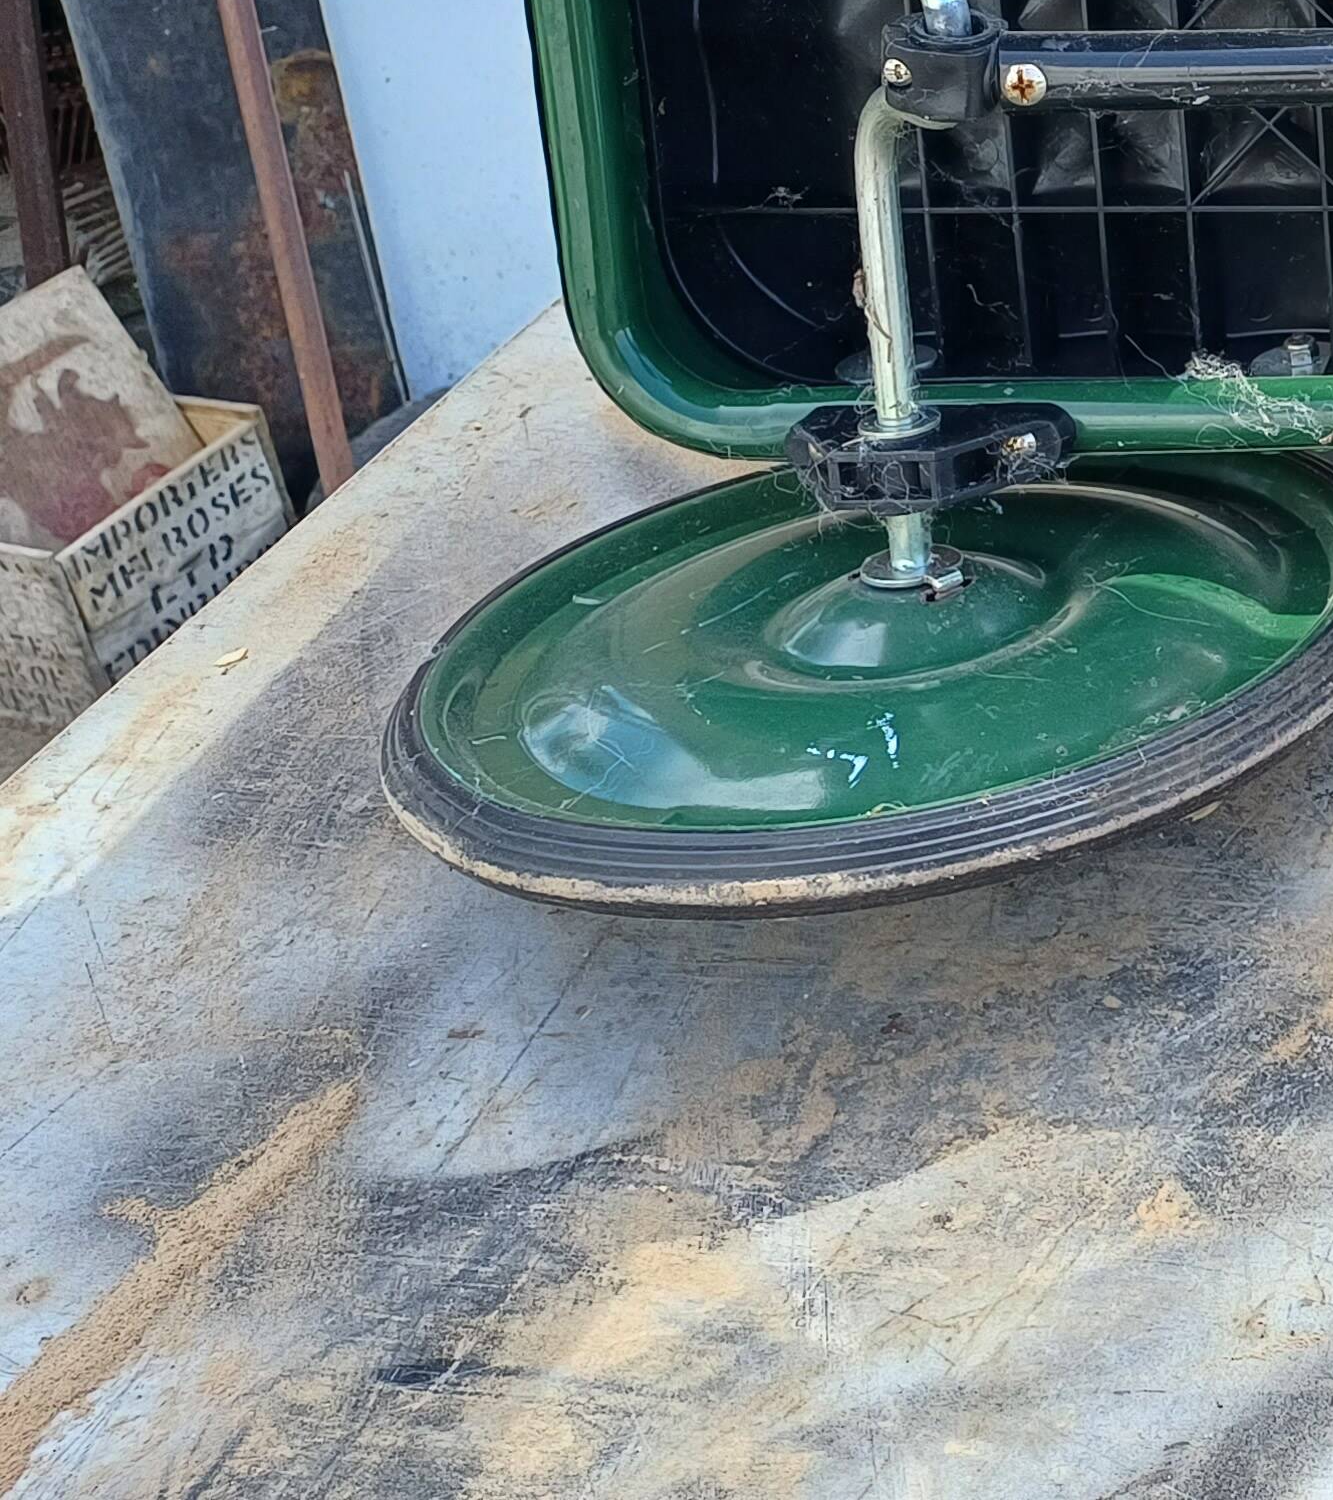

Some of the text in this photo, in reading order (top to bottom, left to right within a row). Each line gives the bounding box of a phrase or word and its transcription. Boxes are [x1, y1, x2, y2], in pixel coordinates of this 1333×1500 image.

[70, 435, 256, 581] IMPORTERS
[89, 461, 271, 613] MELROSES
[151, 533, 235, 615] LTD
